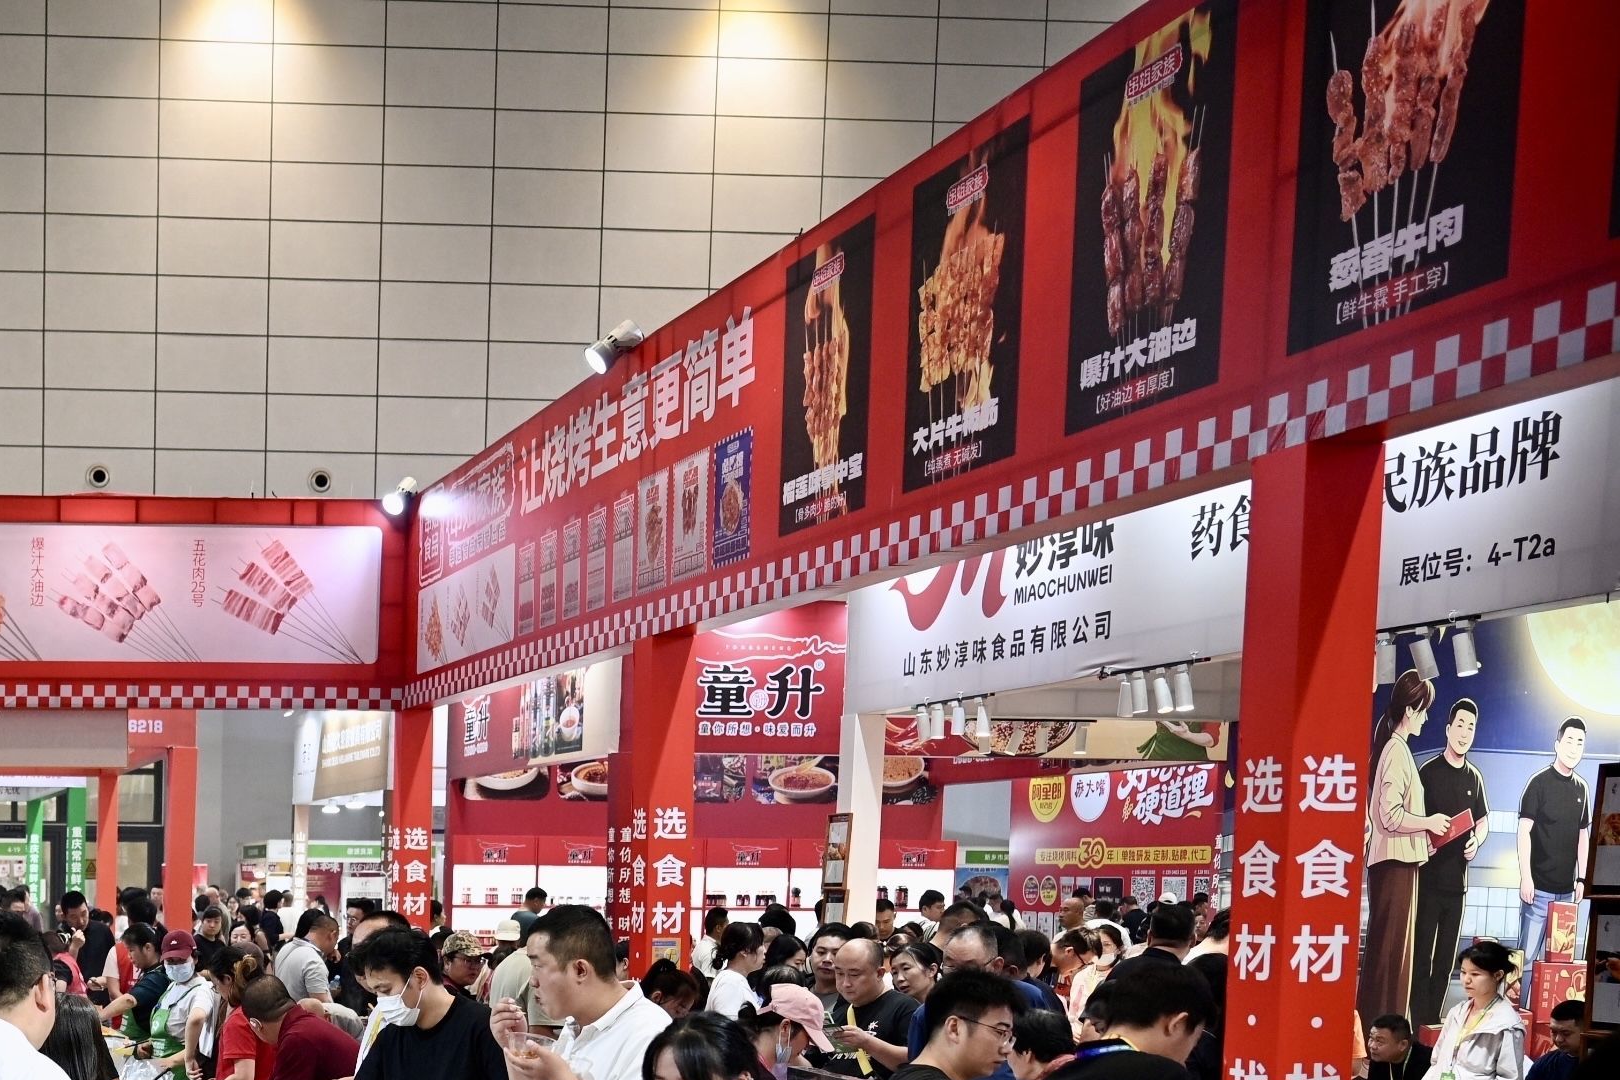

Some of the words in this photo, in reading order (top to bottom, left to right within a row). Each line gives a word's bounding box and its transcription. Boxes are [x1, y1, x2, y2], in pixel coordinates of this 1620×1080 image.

[1128, 48, 1176, 96] 串姐家族
[1329, 205, 1463, 292] 葱香牛肉
[1080, 318, 1197, 391] 爆汁大油边
[519, 307, 756, 517] 让烧烤生意更简单
[1383, 411, 1563, 513] 民族品牌
[30, 537, 45, 607] 爆汁大油边
[191, 539, 206, 607] 五花肉25号
[1015, 520, 1115, 580] 妙淳味
[1487, 533, 1556, 567] 4-T2a
[1014, 564, 1113, 605] MIAOCHUNWEI
[903, 611, 1112, 677] 山东妙淳味食品有限公司
[696, 664, 824, 718] 童升
[1133, 770, 1214, 826] 硬道理
[404, 827, 429, 916] 选食材
[652, 807, 687, 934] 选食材
